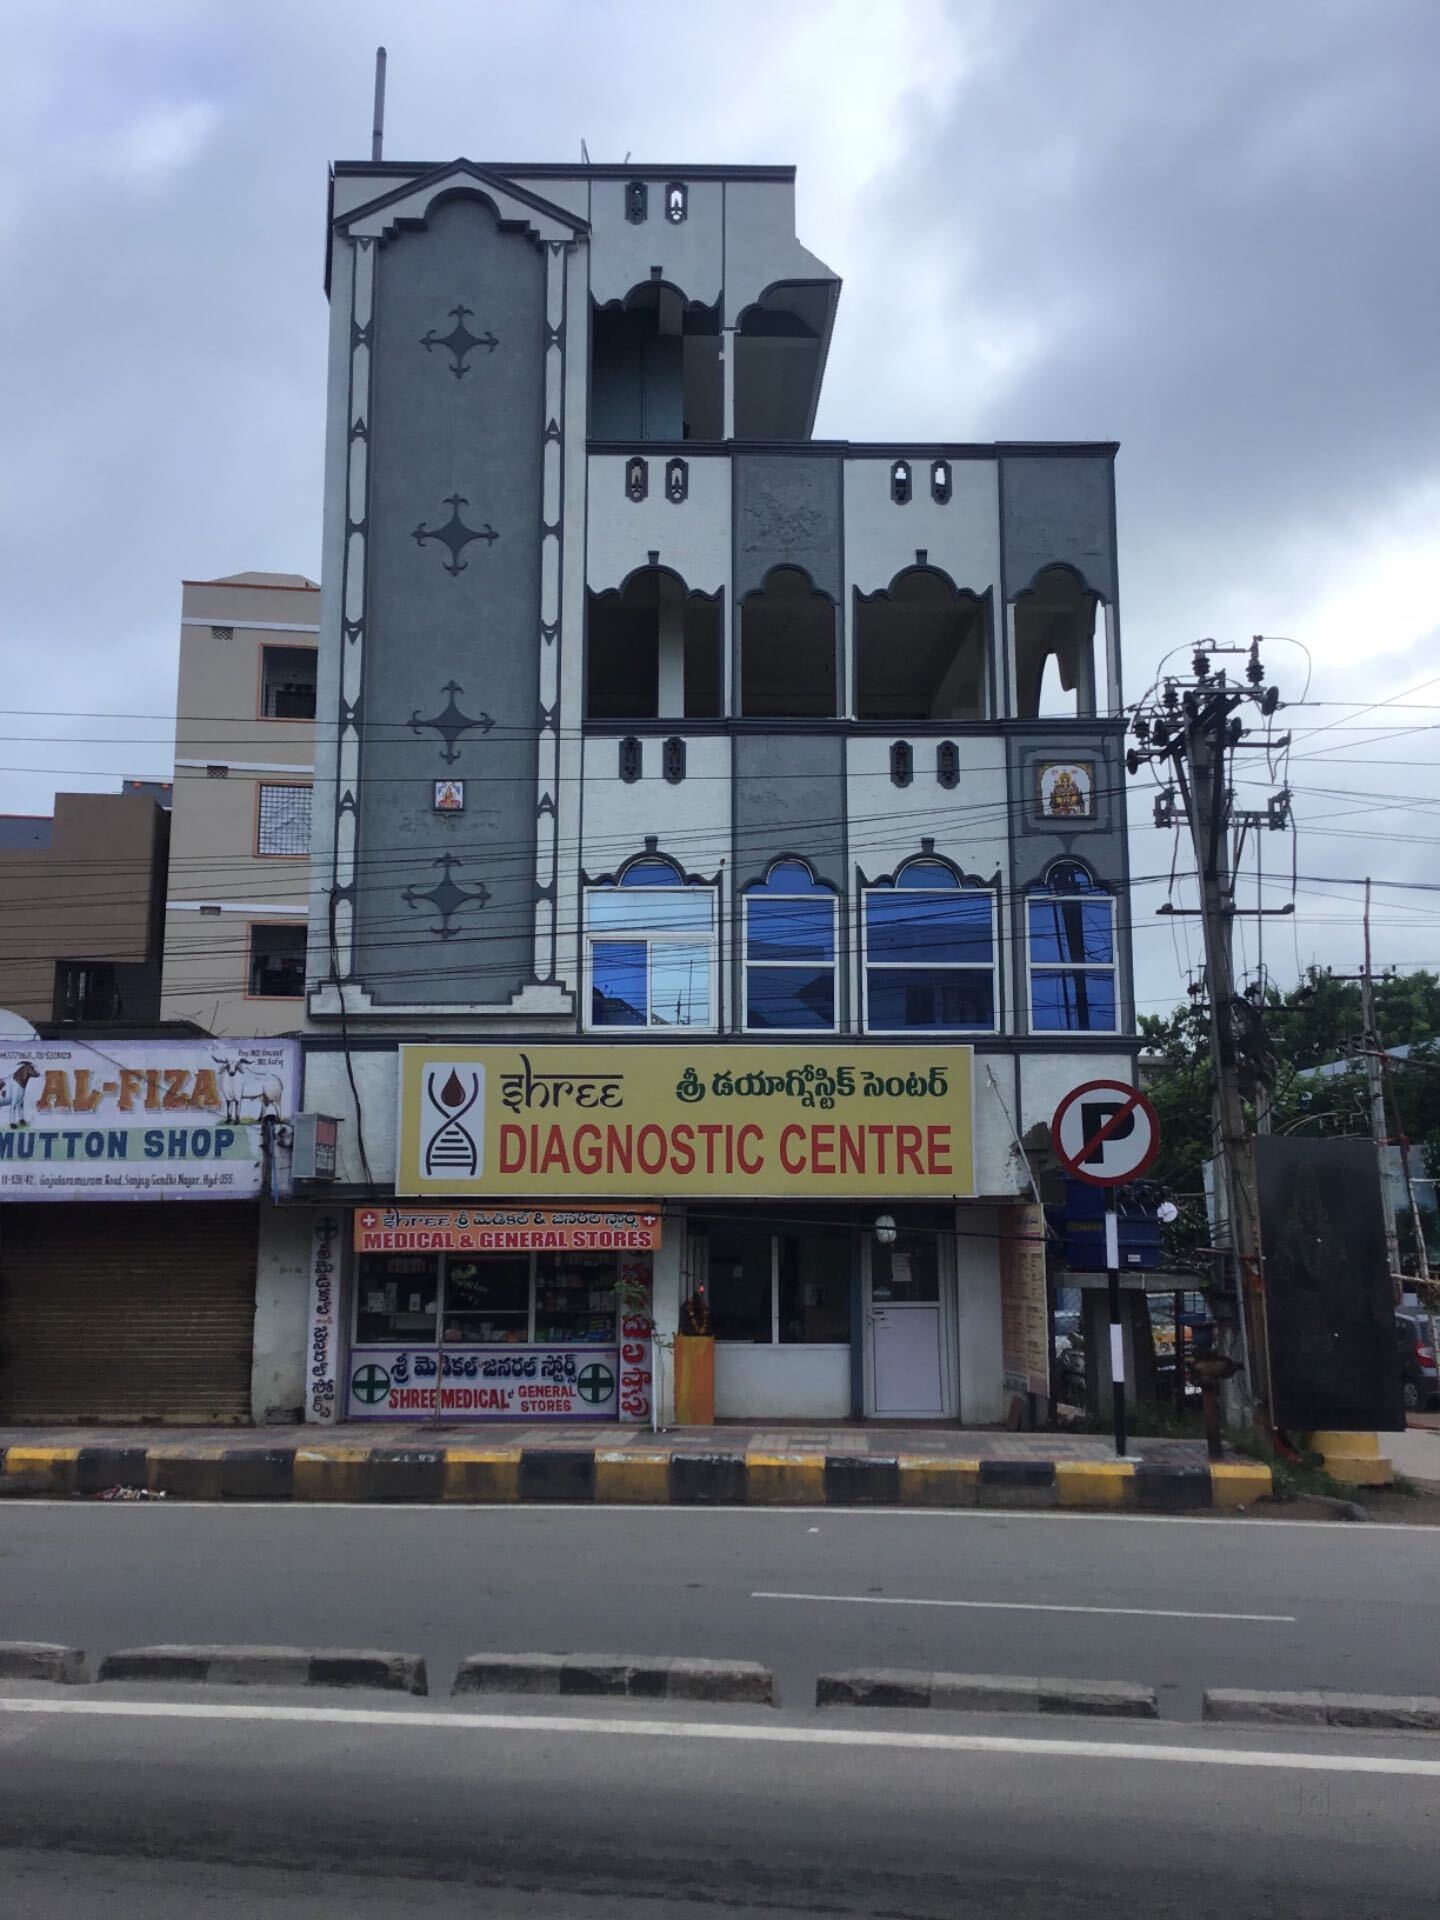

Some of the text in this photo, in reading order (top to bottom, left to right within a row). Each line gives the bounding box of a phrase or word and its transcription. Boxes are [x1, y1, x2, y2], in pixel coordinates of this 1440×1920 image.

[36, 1069, 221, 1112] AL-FIZA
[675, 1064, 948, 1109] శ్రీ డయాగ్నోస్టిక్ సెంటర్
[0, 1128, 235, 1159] MUTTON SHOP
[1080, 1101, 1136, 1164] P
[500, 1123, 953, 1175] DIAGNOSTIC CENTRE
[455, 1209, 469, 1229] శ్రీ
[473, 1210, 529, 1226] మెడికల్
[533, 1212, 546, 1225] &
[363, 1231, 652, 1249] MEDICAL & GENERAL STORES
[390, 1353, 409, 1383] శ్రీ
[482, 1355, 538, 1377] జనరల్
[388, 1388, 437, 1409] SHREE
[440, 1388, 510, 1409] MEDICAL
[518, 1385, 577, 1398] GENERAL
[520, 1400, 572, 1412] STORES
